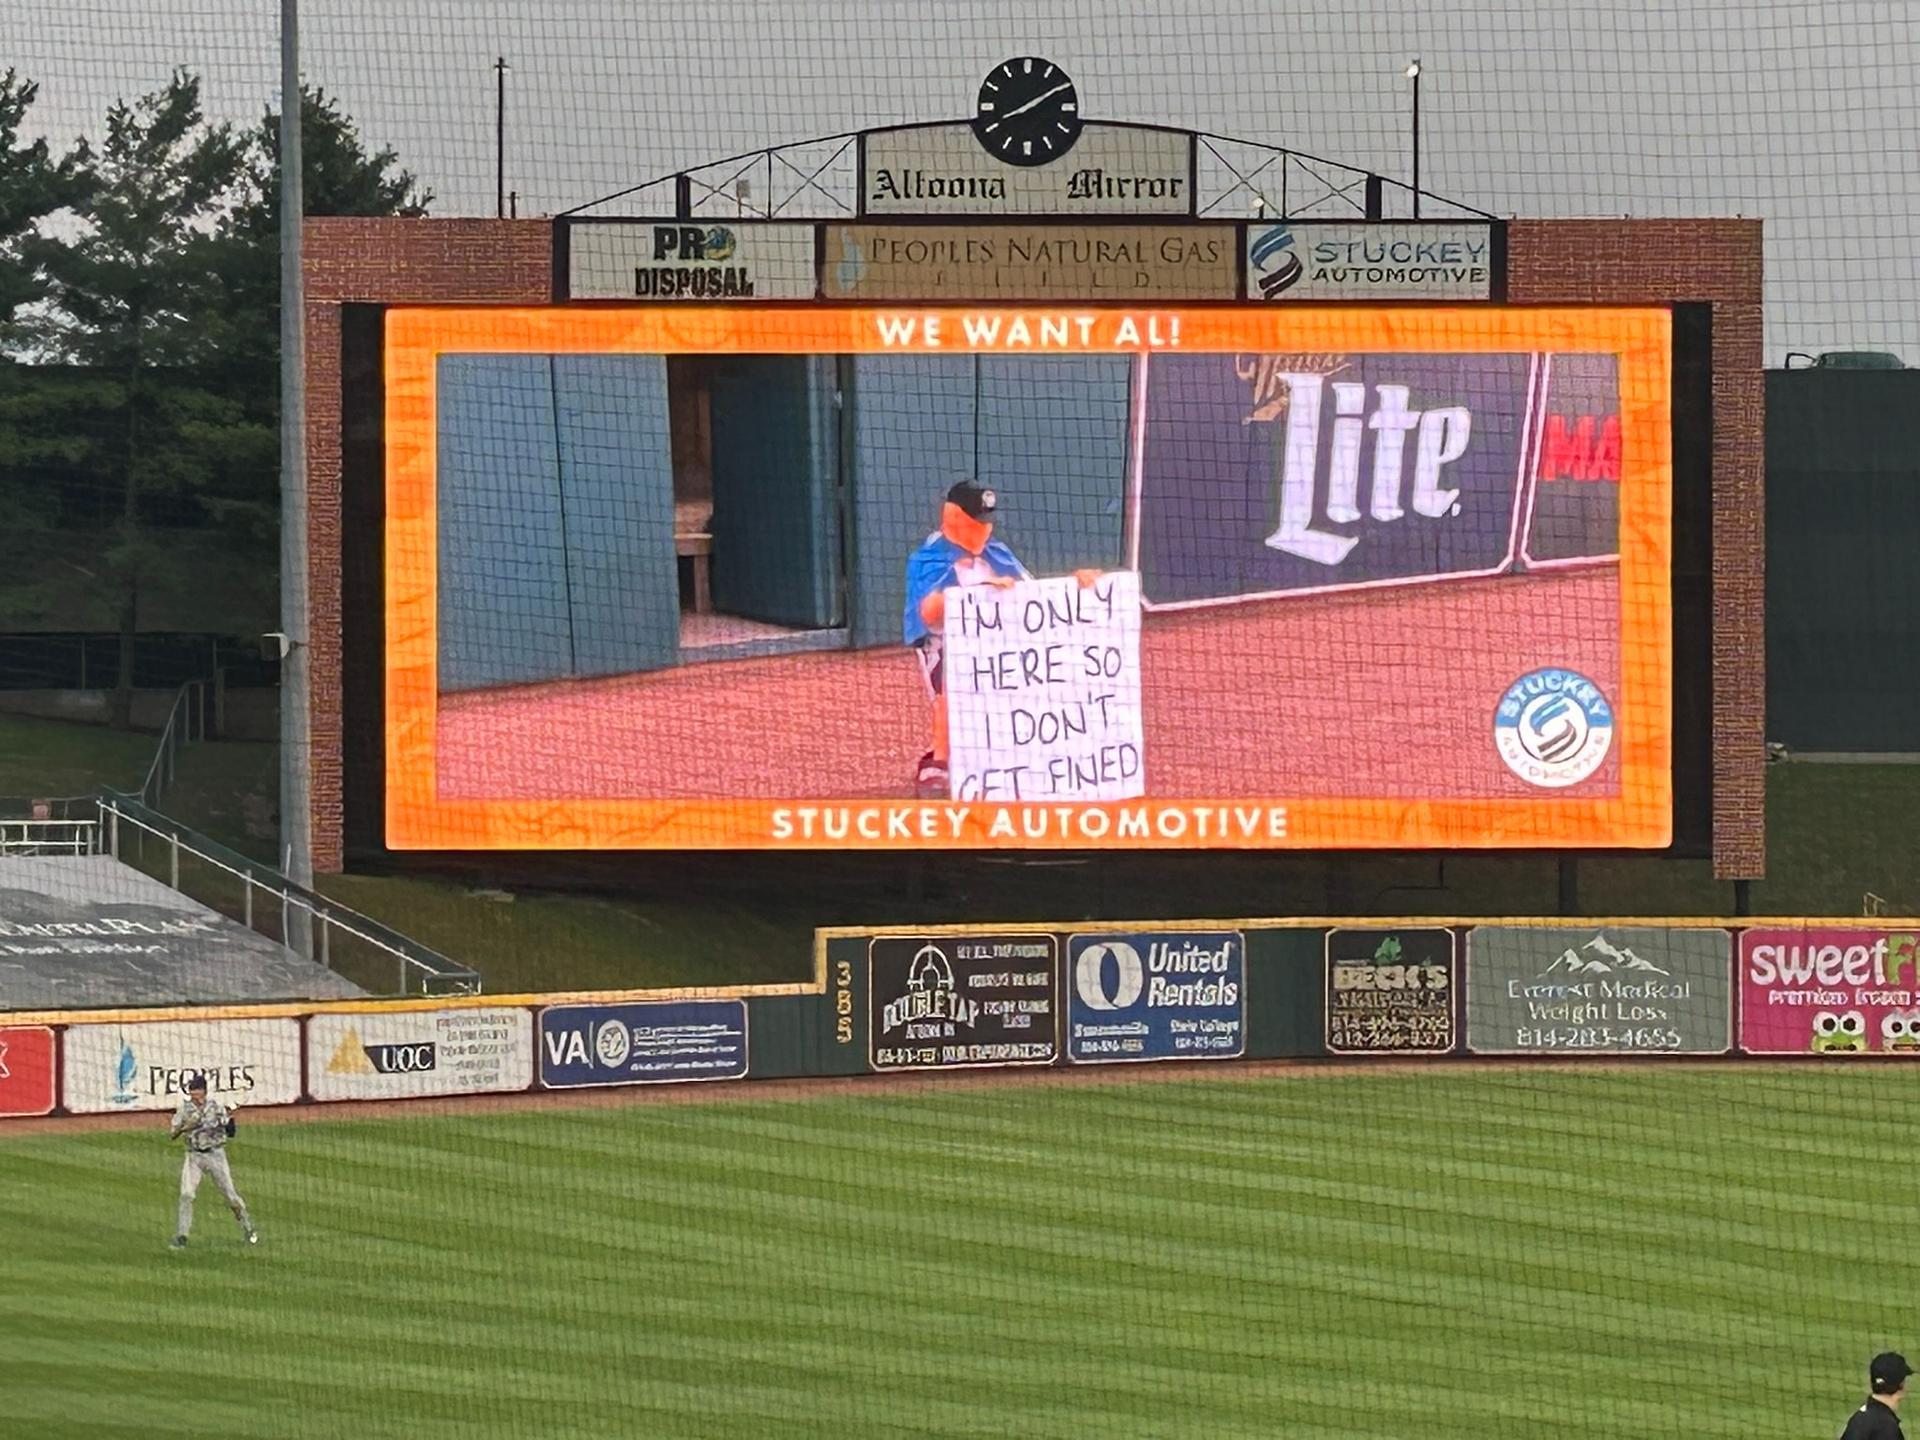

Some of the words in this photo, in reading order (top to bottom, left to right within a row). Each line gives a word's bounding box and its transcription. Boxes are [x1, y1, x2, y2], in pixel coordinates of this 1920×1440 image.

[872, 168, 1007, 200] Altoona
[1066, 168, 1185, 200] Mirror
[872, 238, 994, 265] PEOPLES
[1008, 236, 1149, 265] NATURAL
[1160, 237, 1220, 265] GAS
[1315, 240, 1486, 264] STUCKEY
[635, 266, 754, 297] DISPOSAL
[1311, 267, 1487, 284] AUTOMOTIVE
[876, 315, 941, 347] WE
[962, 315, 1097, 347] WANT
[1114, 315, 1181, 347] AL!
[960, 592, 1003, 638] I'M
[1023, 581, 1115, 634] ONLY
[972, 644, 1066, 692] HERE
[1083, 645, 1122, 679] SO
[1499, 670, 1612, 718] STUCKEY
[985, 713, 991, 750] I
[1010, 691, 1116, 747] DON'T
[958, 765, 1030, 801] GET
[1048, 742, 1139, 794] FINED
[771, 806, 970, 840] STUCKEY
[988, 806, 1289, 840] AUTOMOTIVE
[1149, 940, 1232, 973] United
[1750, 933, 1920, 986] sweetF
[1147, 975, 1239, 1008] Rentals
[1528, 1001, 1608, 1025] Weight
[1617, 1002, 1668, 1022] Loss
[381, 1045, 432, 1073] UOC
[545, 1030, 590, 1066] VA
